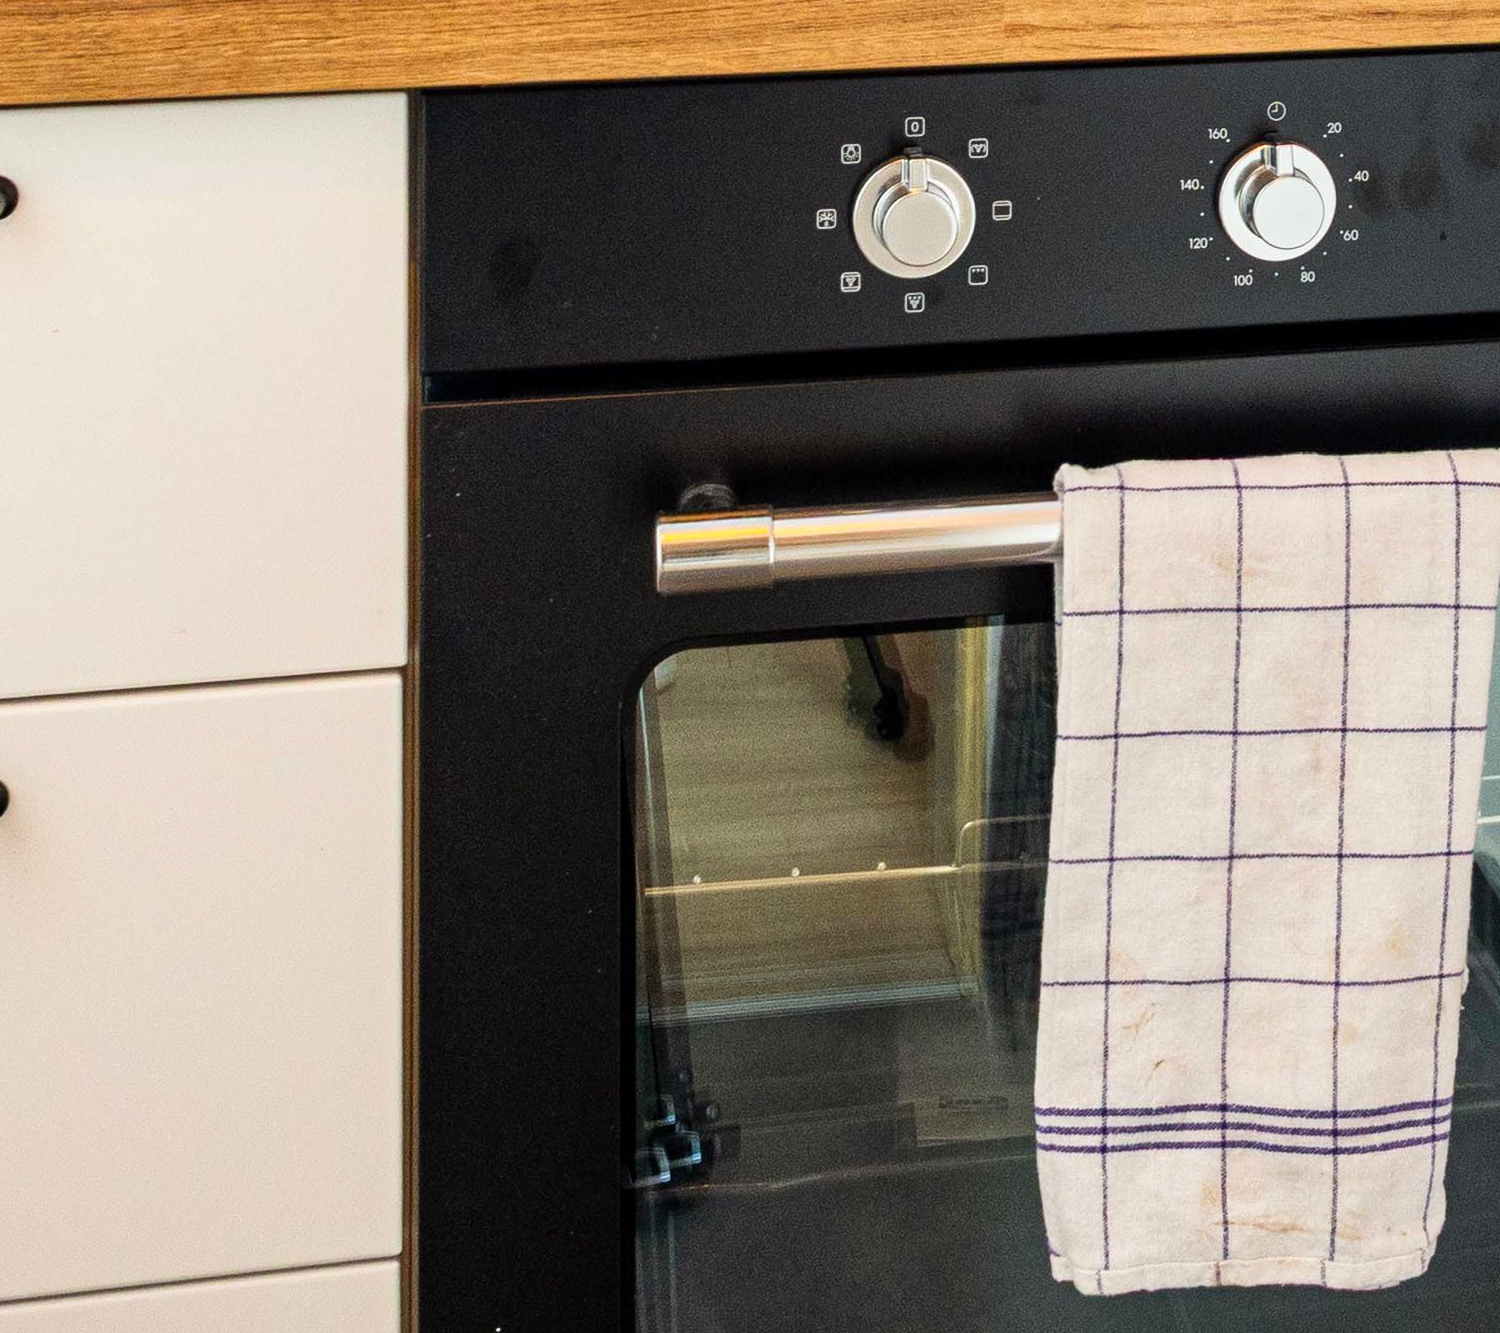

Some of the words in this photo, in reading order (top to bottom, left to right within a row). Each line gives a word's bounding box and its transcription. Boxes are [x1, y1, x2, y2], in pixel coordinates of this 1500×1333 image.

[911, 122, 919, 132] 0
[1326, 121, 1342, 134] 20
[1207, 127, 1228, 140] 160
[1353, 170, 1369, 182] 40
[1179, 179, 1200, 191] 140
[1343, 229, 1359, 242] 60
[1188, 237, 1209, 250] 120
[1233, 274, 1253, 286] 100
[1300, 271, 1316, 283] 80
